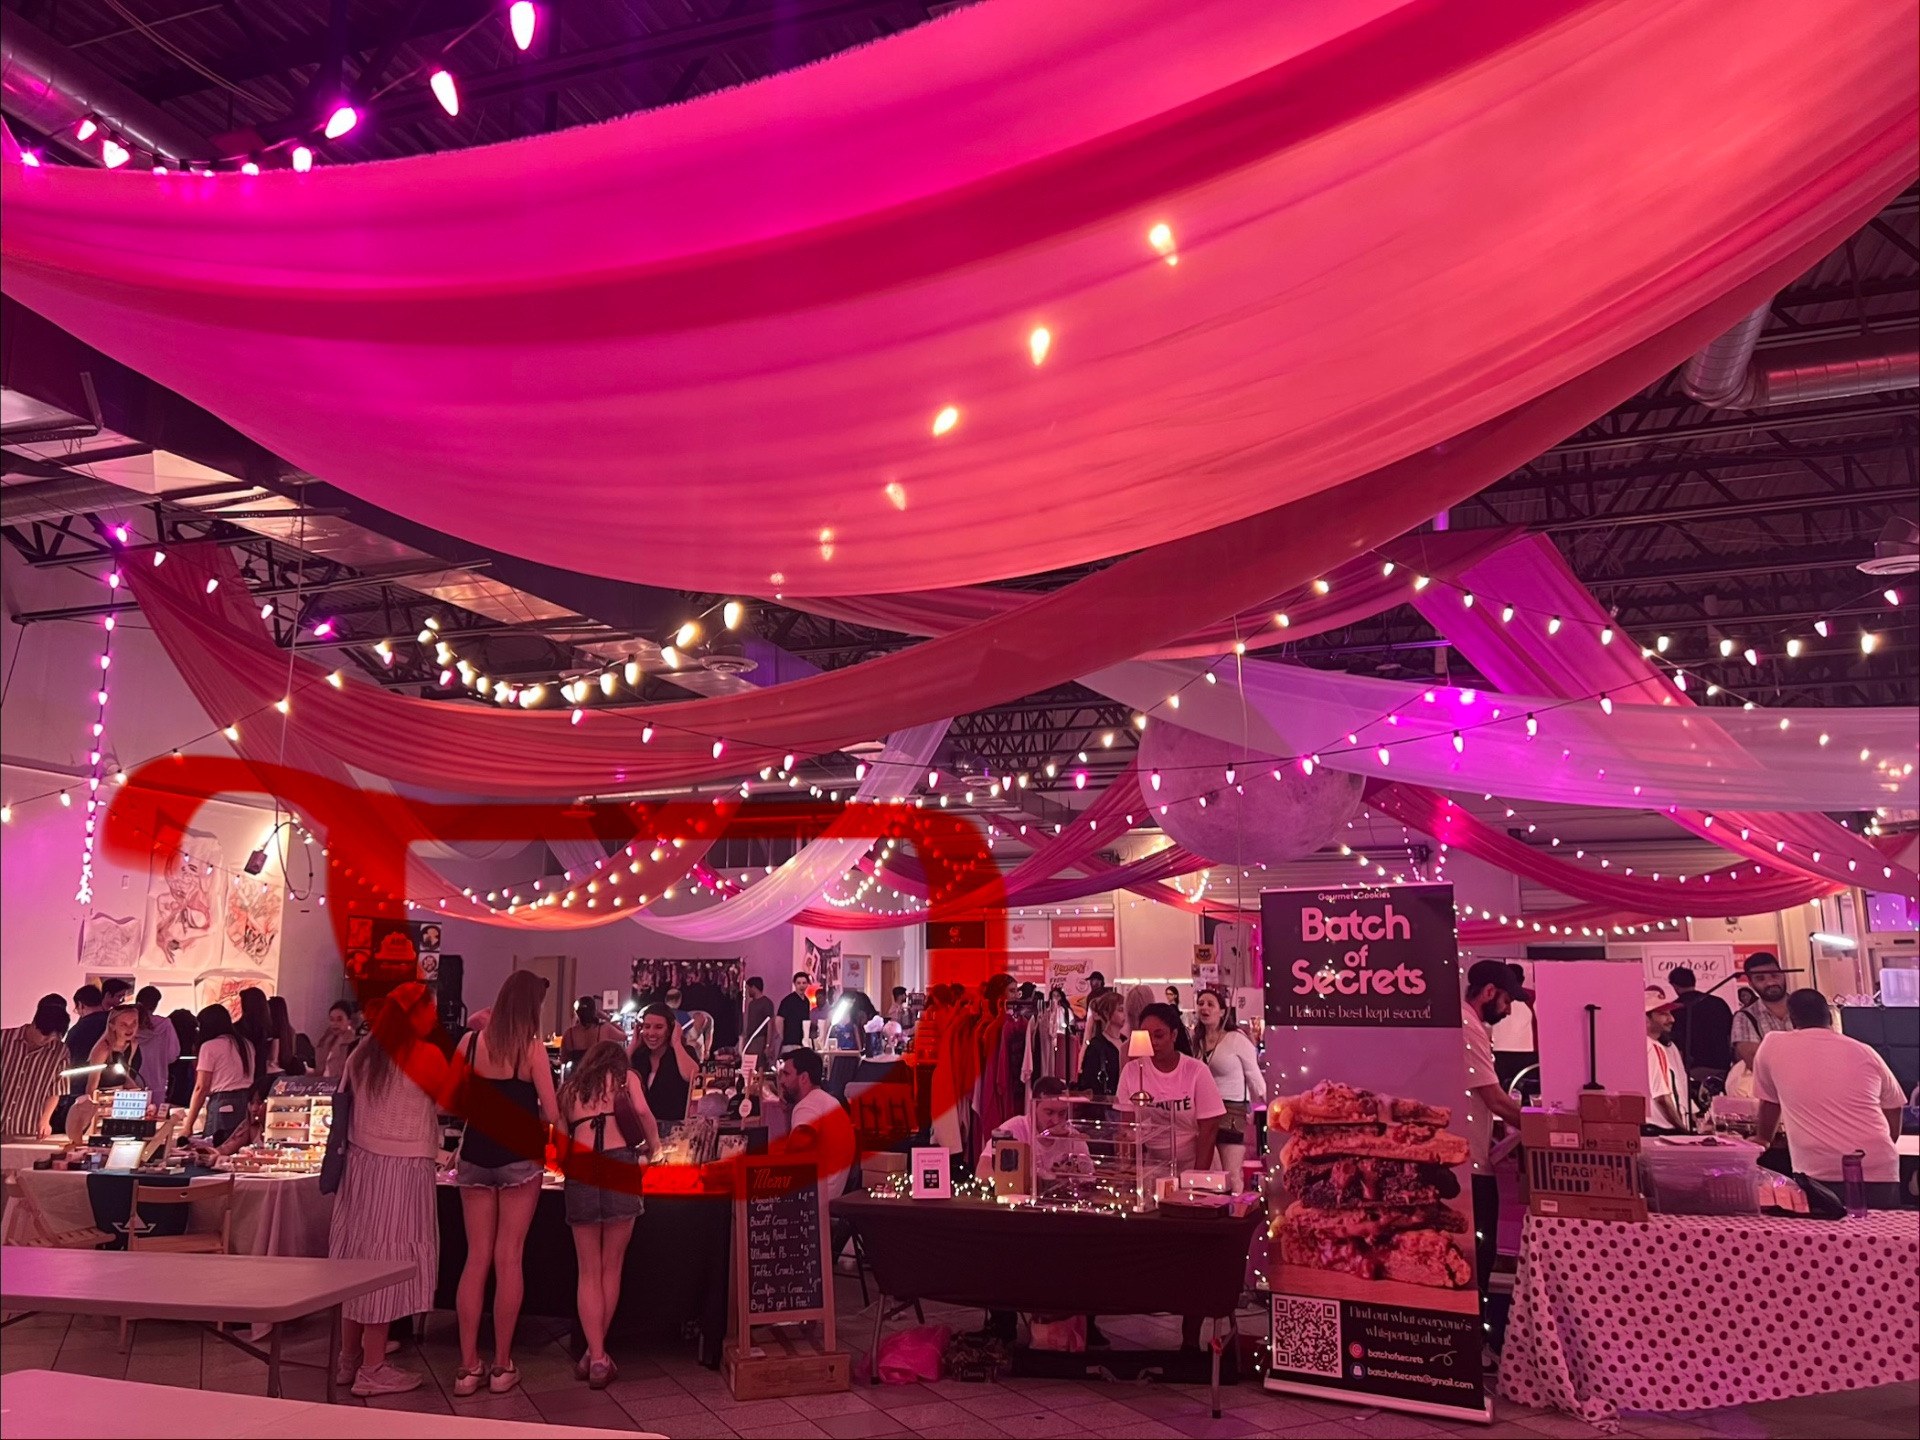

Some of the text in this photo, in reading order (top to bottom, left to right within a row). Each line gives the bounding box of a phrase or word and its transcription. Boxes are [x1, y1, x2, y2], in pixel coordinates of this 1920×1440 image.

[1318, 889, 1391, 901] Gourmet Cookies
[1301, 904, 1411, 942] Batch
[1344, 944, 1369, 967] of
[1291, 959, 1427, 995] Secrets
[1338, 1004, 1363, 1018] best
[1365, 1004, 1390, 1022] kept
[1392, 1004, 1431, 1019] secret!
[753, 1168, 792, 1189] Menu
[750, 1230, 771, 1246] Rocky
[772, 1228, 787, 1241] Road
[751, 1264, 772, 1277] Toffee
[750, 1298, 765, 1312] Buy
[767, 1297, 774, 1309] 5
[776, 1297, 787, 1311] get
[1349, 1305, 1473, 1332] Find out what everyone's
[1365, 1325, 1452, 1346] whispering about!
[1367, 1348, 1424, 1364] batchofsecrets
[1367, 1367, 1474, 1390] batchofsecrets@gmail.com
